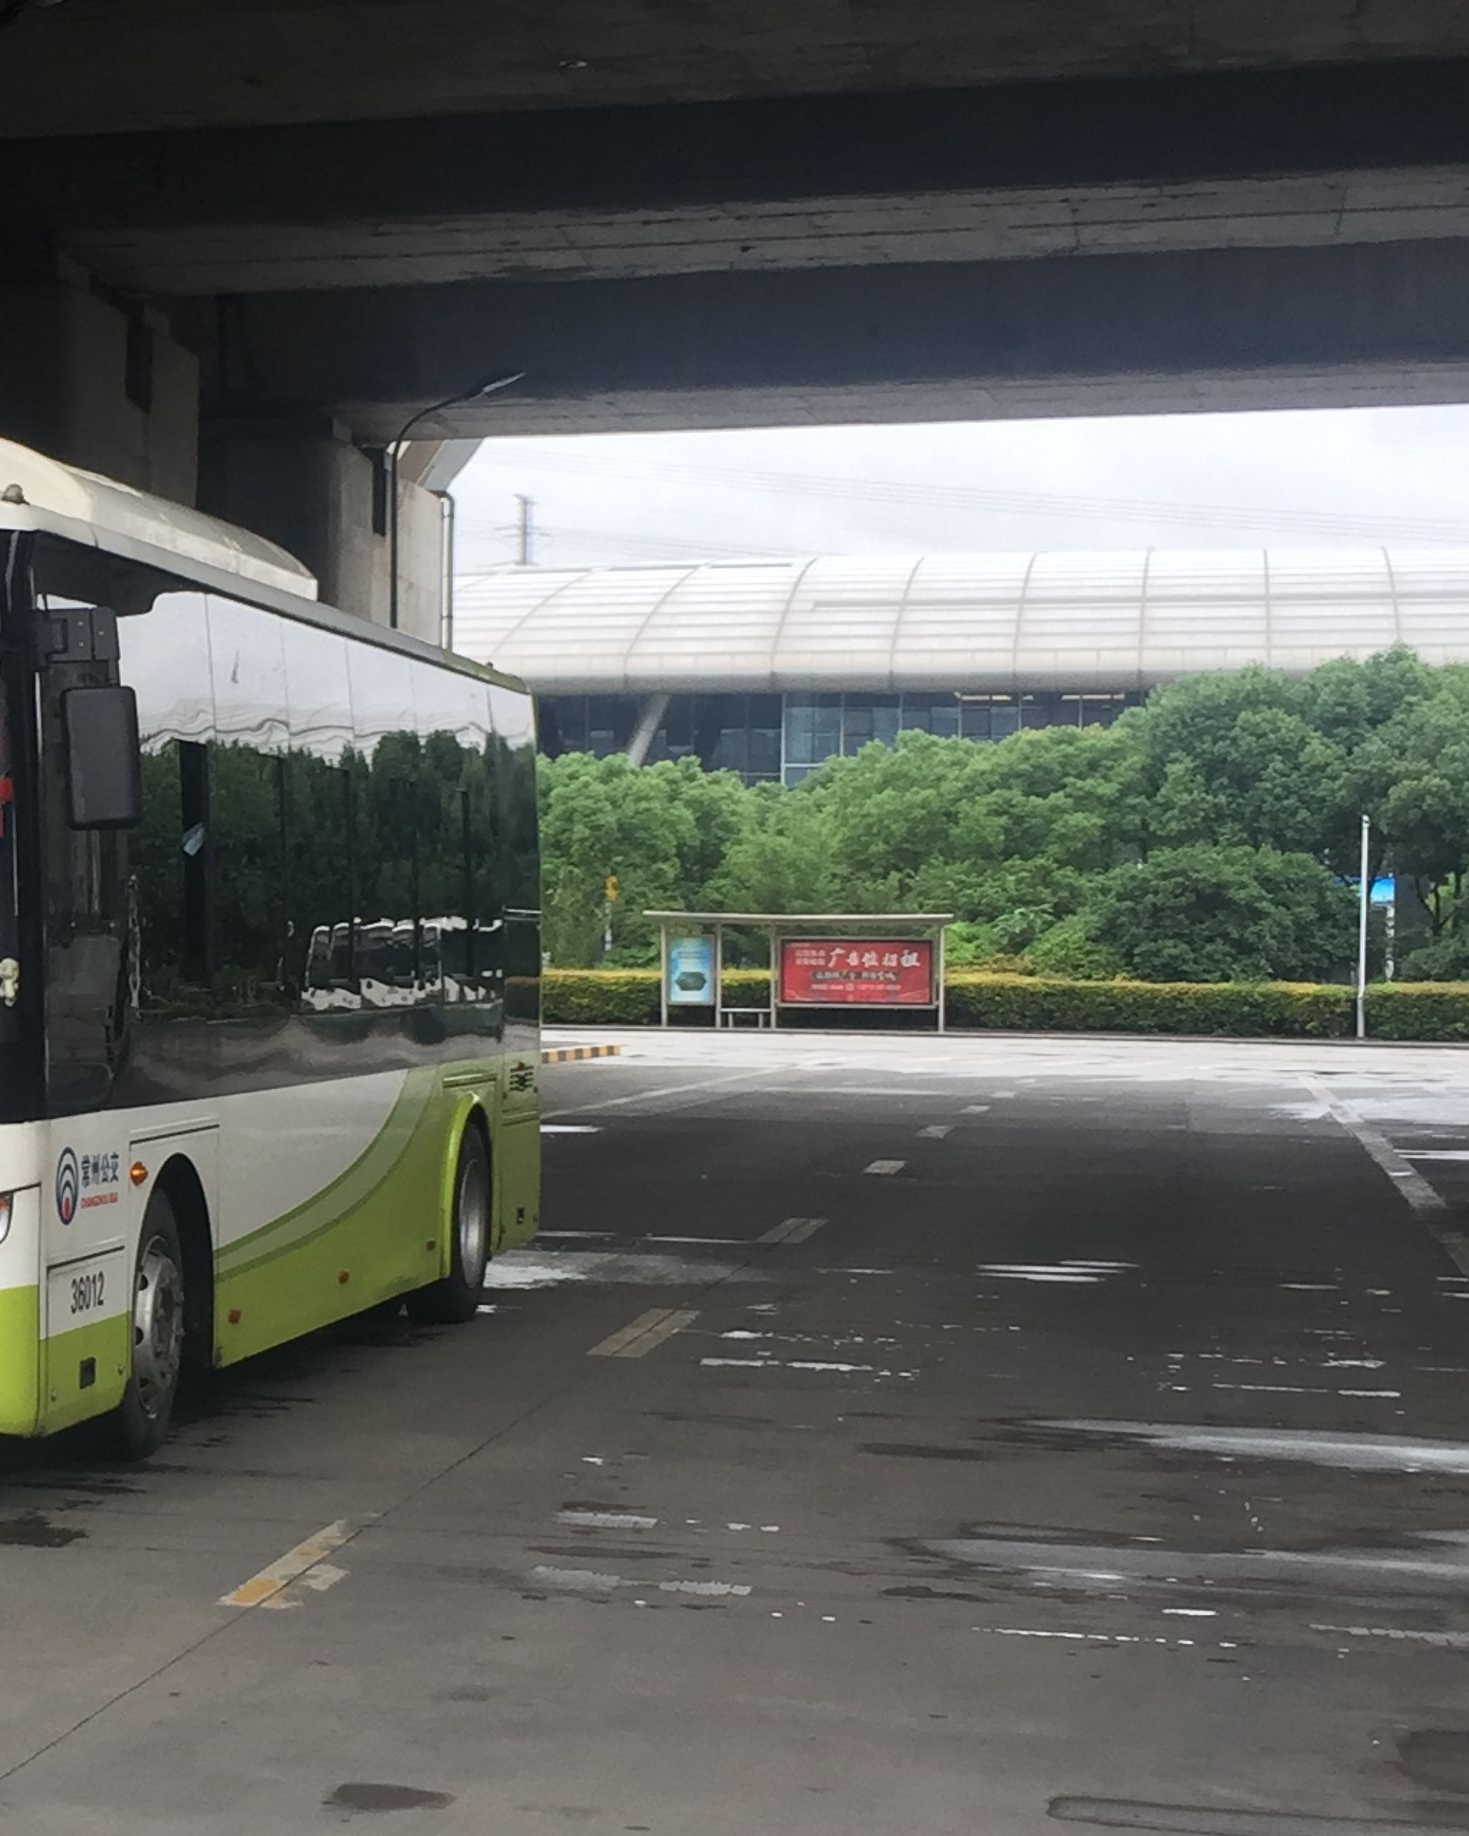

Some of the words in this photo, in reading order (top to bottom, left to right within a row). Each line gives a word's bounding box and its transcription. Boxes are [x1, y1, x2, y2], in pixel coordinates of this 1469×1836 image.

[81, 1152, 119, 1188] 常州公交
[71, 1271, 104, 1314] 36012
